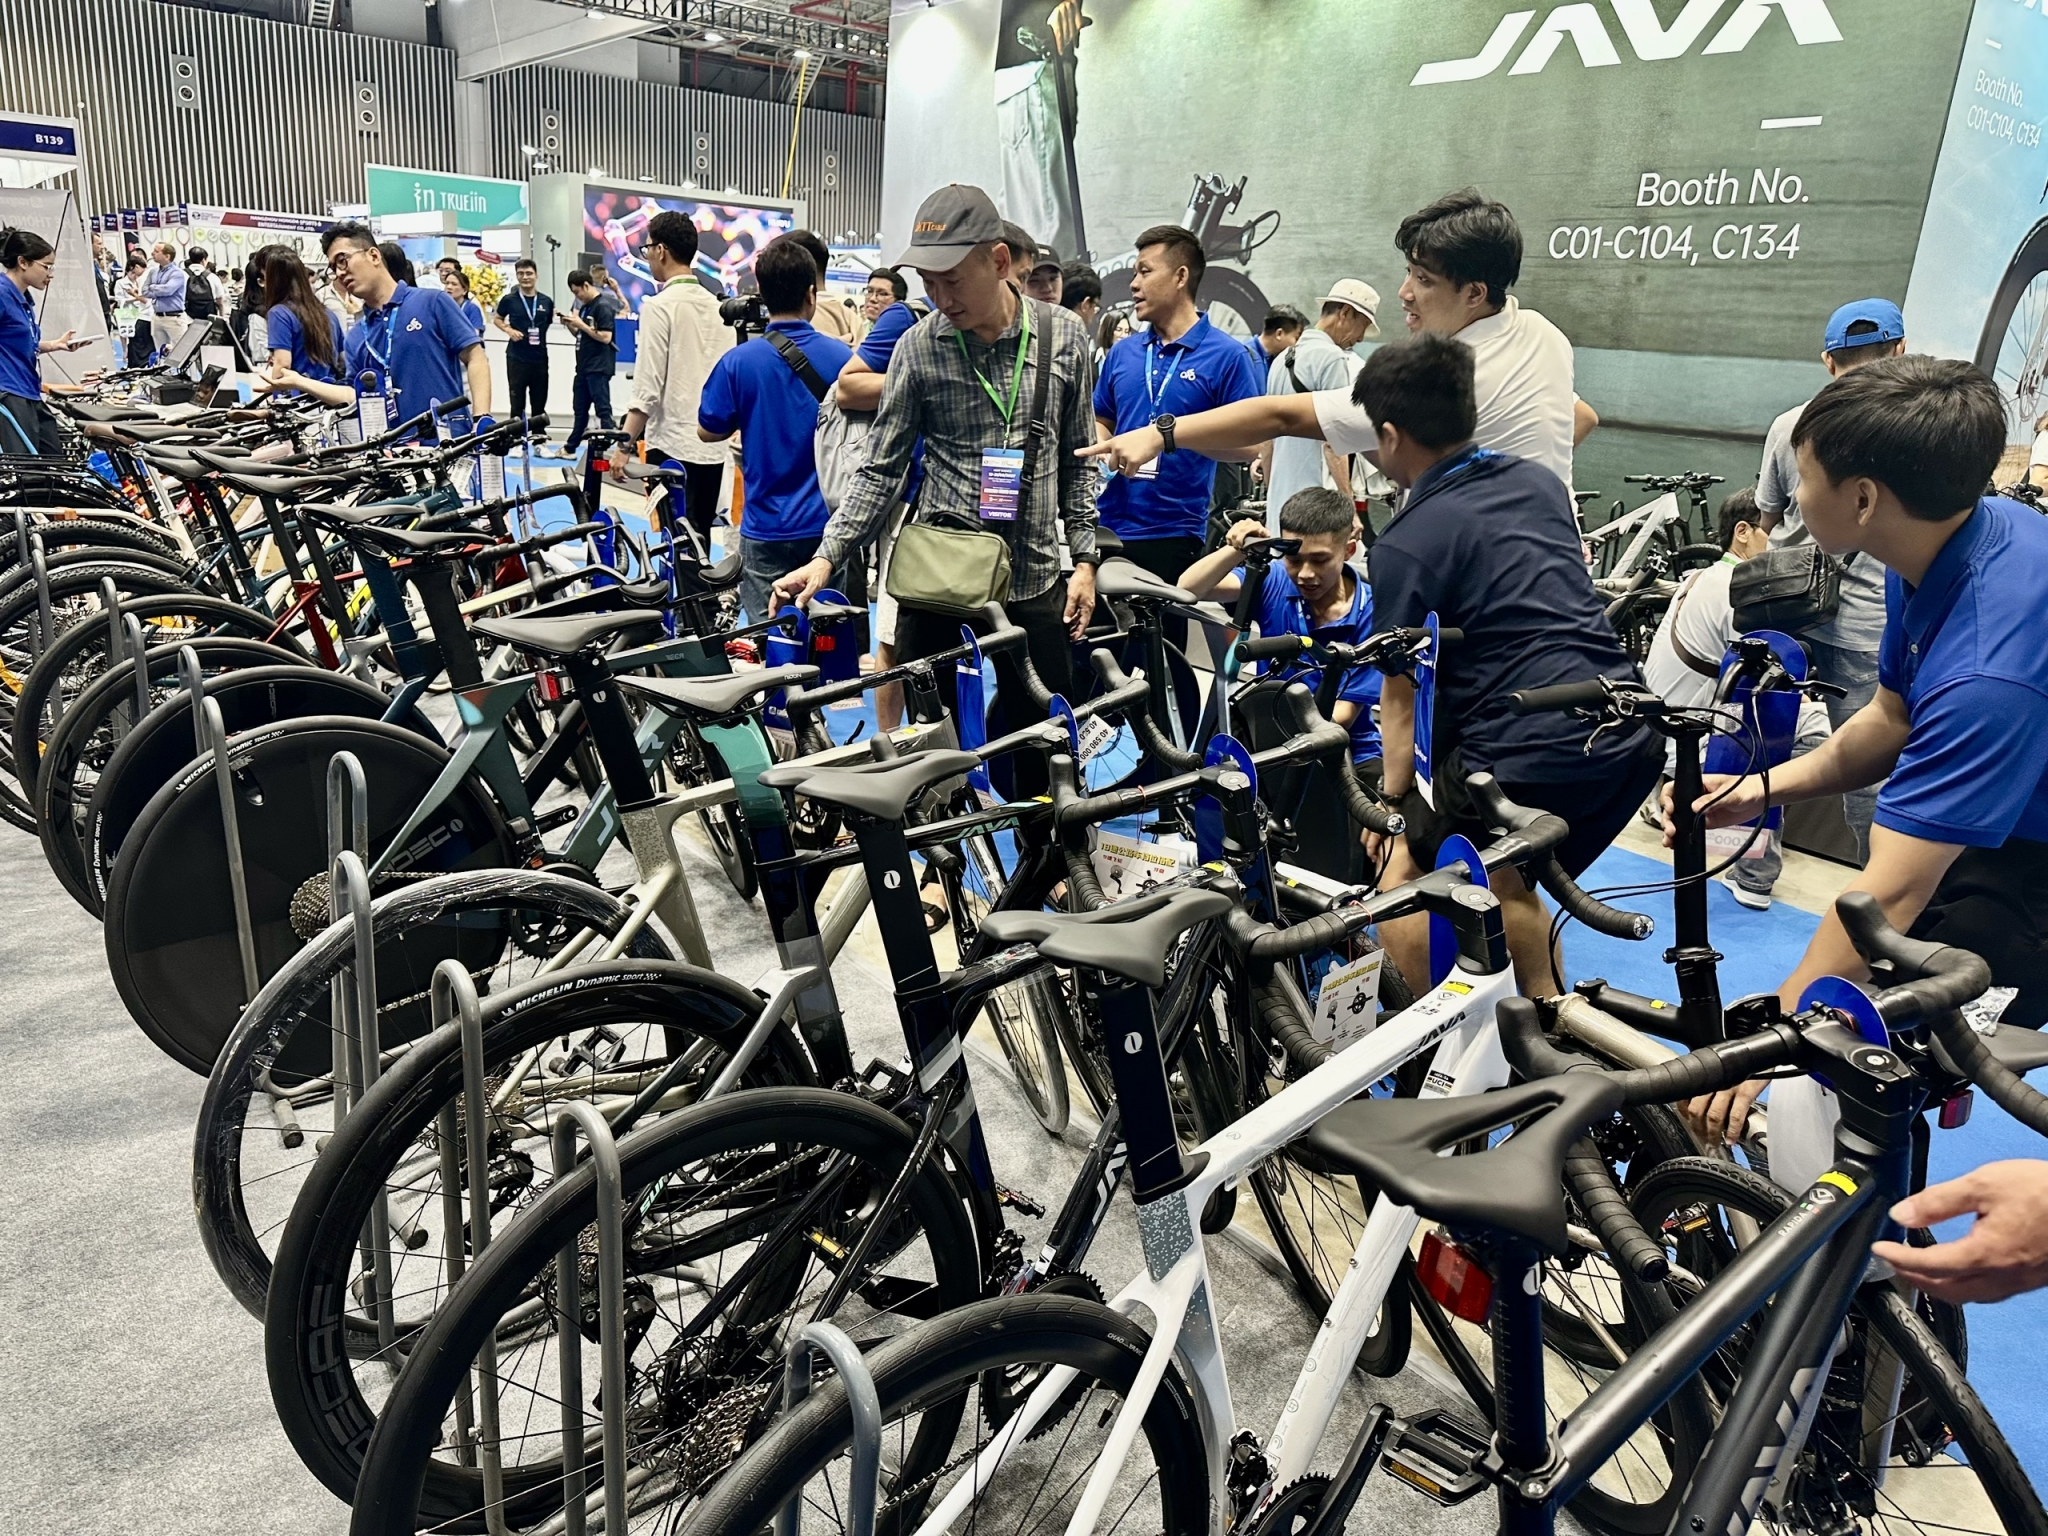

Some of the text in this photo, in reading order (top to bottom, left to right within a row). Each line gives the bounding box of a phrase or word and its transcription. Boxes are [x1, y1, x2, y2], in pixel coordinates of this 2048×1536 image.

[1409, 0, 1844, 86] JAVA
[1975, 69, 2023, 108] Booth No.
[35, 134, 64, 146] B139
[1967, 104, 2042, 149] C01-C104, C134
[1636, 167, 1810, 207] Booth No.
[1548, 223, 1800, 266] C01-C104, C134
[942, 816, 1020, 844] JAVA
[515, 972, 644, 1012] MICHELIN Dynamic sport
[1405, 1010, 1467, 1059] JAVA
[1432, 1077, 1446, 1088] UCI
[1777, 1211, 1808, 1237] RAPIDA
[1107, 1332, 1144, 1356] CHAO YANG
